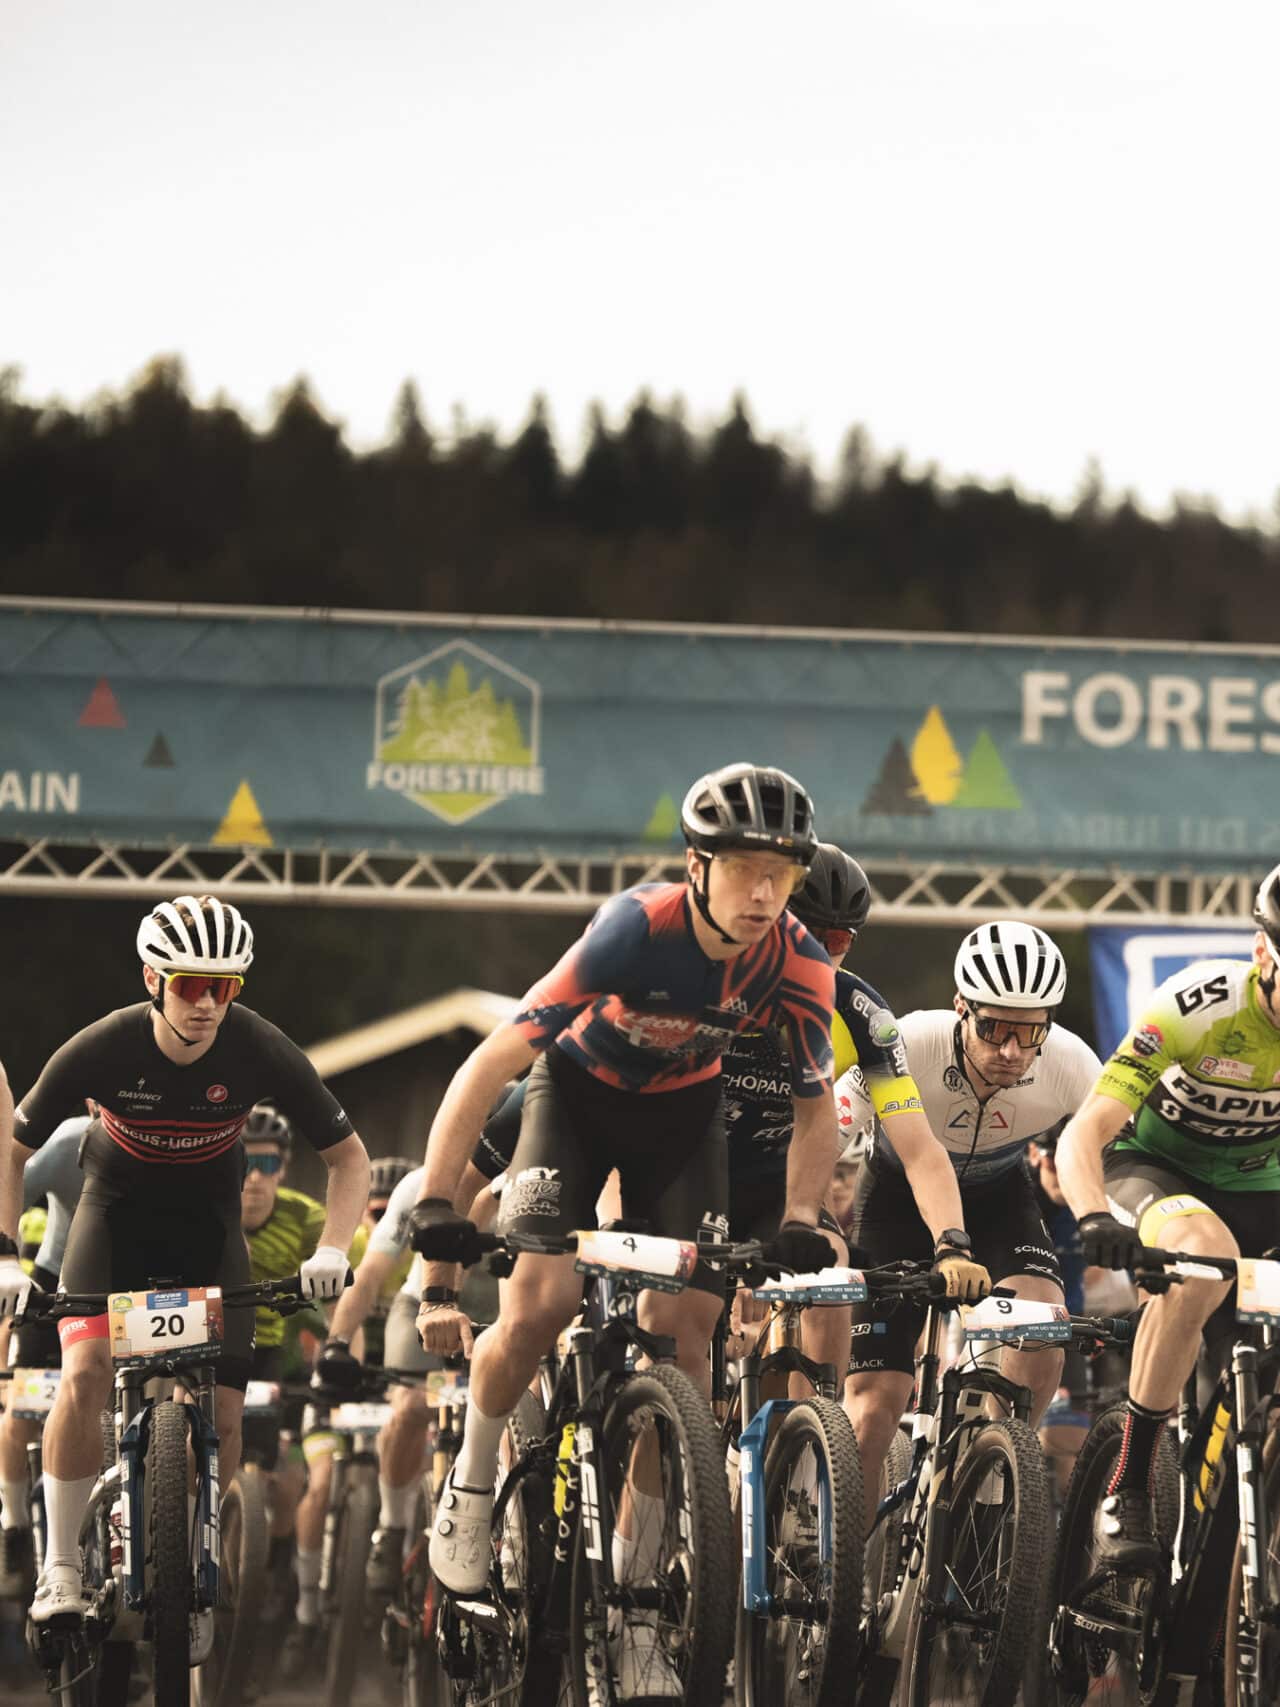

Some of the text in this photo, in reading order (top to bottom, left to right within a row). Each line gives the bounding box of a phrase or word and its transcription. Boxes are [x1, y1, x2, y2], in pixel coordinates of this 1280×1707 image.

[367, 763, 544, 795] FORESTIERE
[1175, 976, 1229, 1016] GS
[117, 1090, 162, 1101] DAVINCI
[623, 1237, 638, 1253] 4
[996, 1300, 1012, 1314] 9
[150, 1314, 185, 1337] 20
